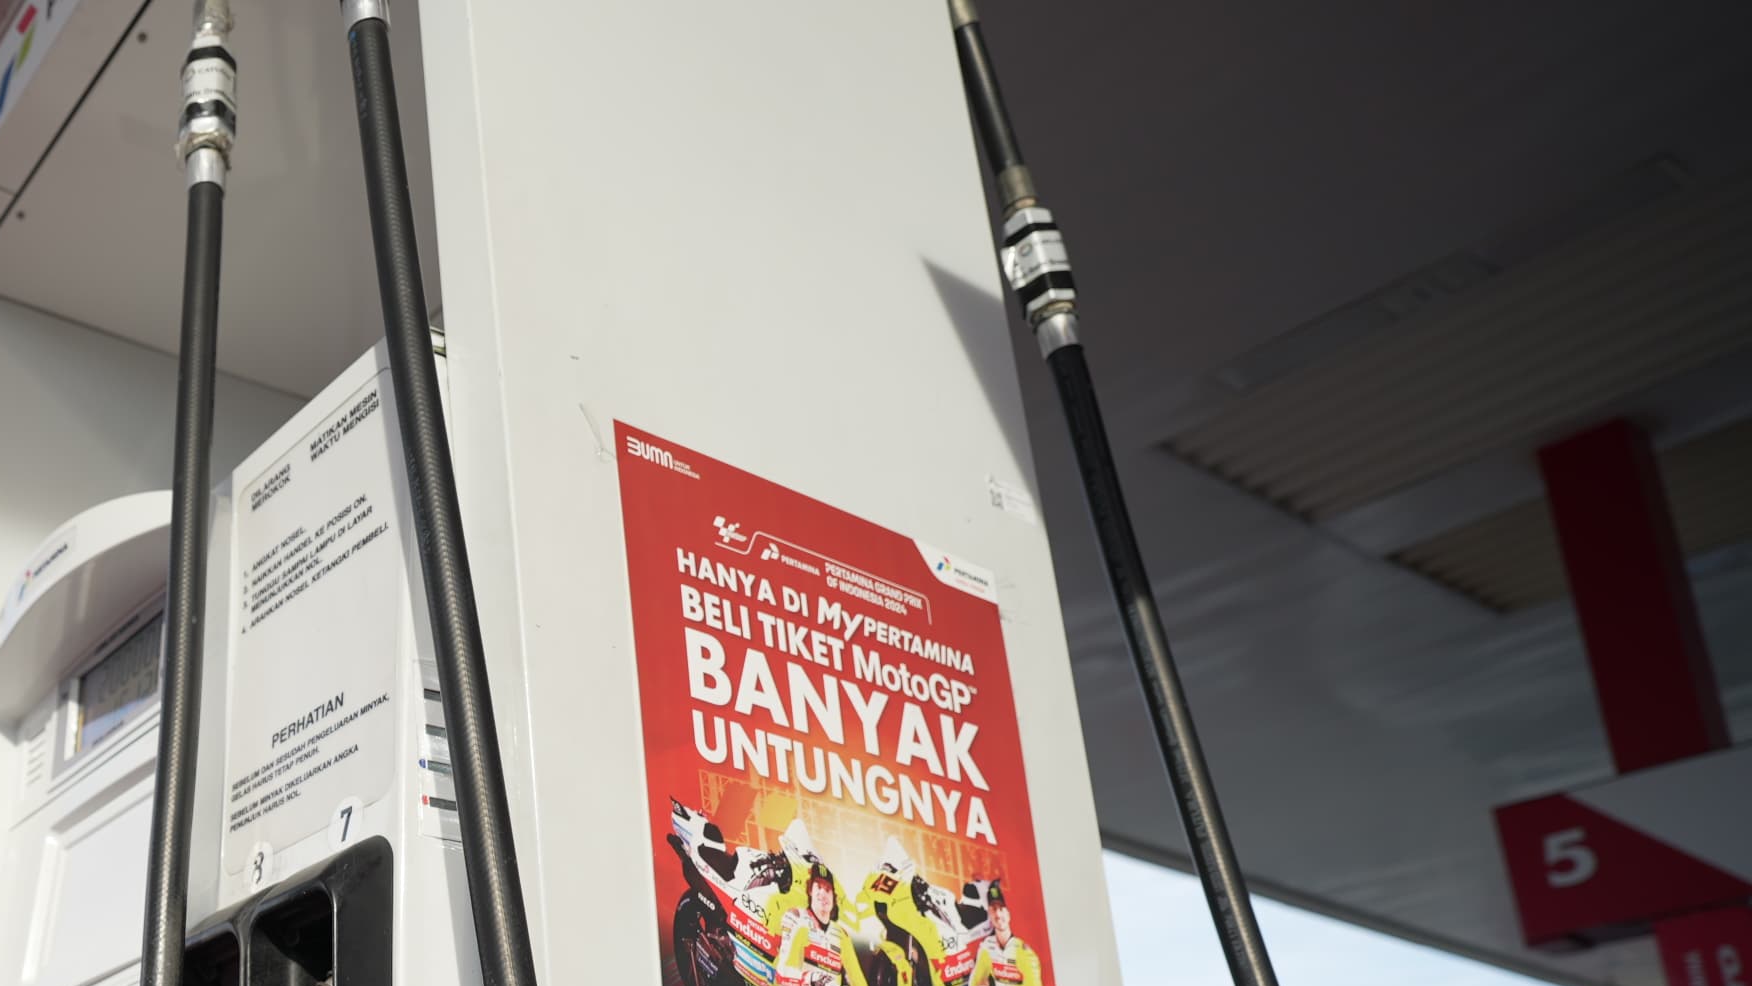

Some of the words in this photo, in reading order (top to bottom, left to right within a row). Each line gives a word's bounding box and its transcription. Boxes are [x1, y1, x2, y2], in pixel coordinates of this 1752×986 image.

[310, 414, 348, 452] MATIKAN
[349, 389, 378, 419] MESIN
[310, 431, 341, 462] WAKTU
[342, 398, 379, 436] MENGISI
[251, 463, 291, 502] DILARANG
[251, 475, 291, 512] MEROKOK
[251, 559, 282, 587] NAIKKAN
[314, 525, 325, 540] KE
[326, 504, 352, 530] POSISI
[251, 544, 279, 571] ANGKAT
[282, 554, 308, 580] SAMPAI
[310, 533, 336, 559] LAMPU
[337, 525, 346, 538] DI
[347, 505, 373, 531] LAYAR
[780, 555, 821, 577] PERTAMINA
[676, 547, 776, 606] HANYA
[782, 586, 809, 618] DI
[824, 561, 874, 589] PERTAMINA
[875, 581, 903, 600] GRAND
[904, 591, 923, 610] PRIX
[826, 574, 839, 588] OF
[839, 580, 884, 608] INDONESIA
[884, 598, 908, 615] 2024
[680, 583, 751, 640] BELI
[757, 611, 845, 672] TIKET
[271, 692, 344, 749] PERHATIAN
[684, 626, 990, 792] BANYAK
[230, 784, 252, 803] GELAS
[252, 772, 274, 791] HARUS
[274, 761, 294, 777] TETAP
[231, 770, 260, 793] SEBELUM
[261, 761, 275, 776] DAN
[275, 742, 306, 767] SESUDAH
[307, 711, 359, 750] PENGELUARAN
[691, 708, 998, 846] UNTUNGNYA
[229, 801, 259, 824] SEBELUM
[260, 786, 284, 806] MINYAK
[284, 759, 333, 792] DIKELUARKAN
[333, 743, 359, 765] ANGKA
[229, 809, 262, 833] PENUNJUK
[262, 799, 285, 815] HARUS
[339, 806, 353, 843] 7
[1543, 826, 1600, 889] 5
[729, 912, 772, 951] Enduro
